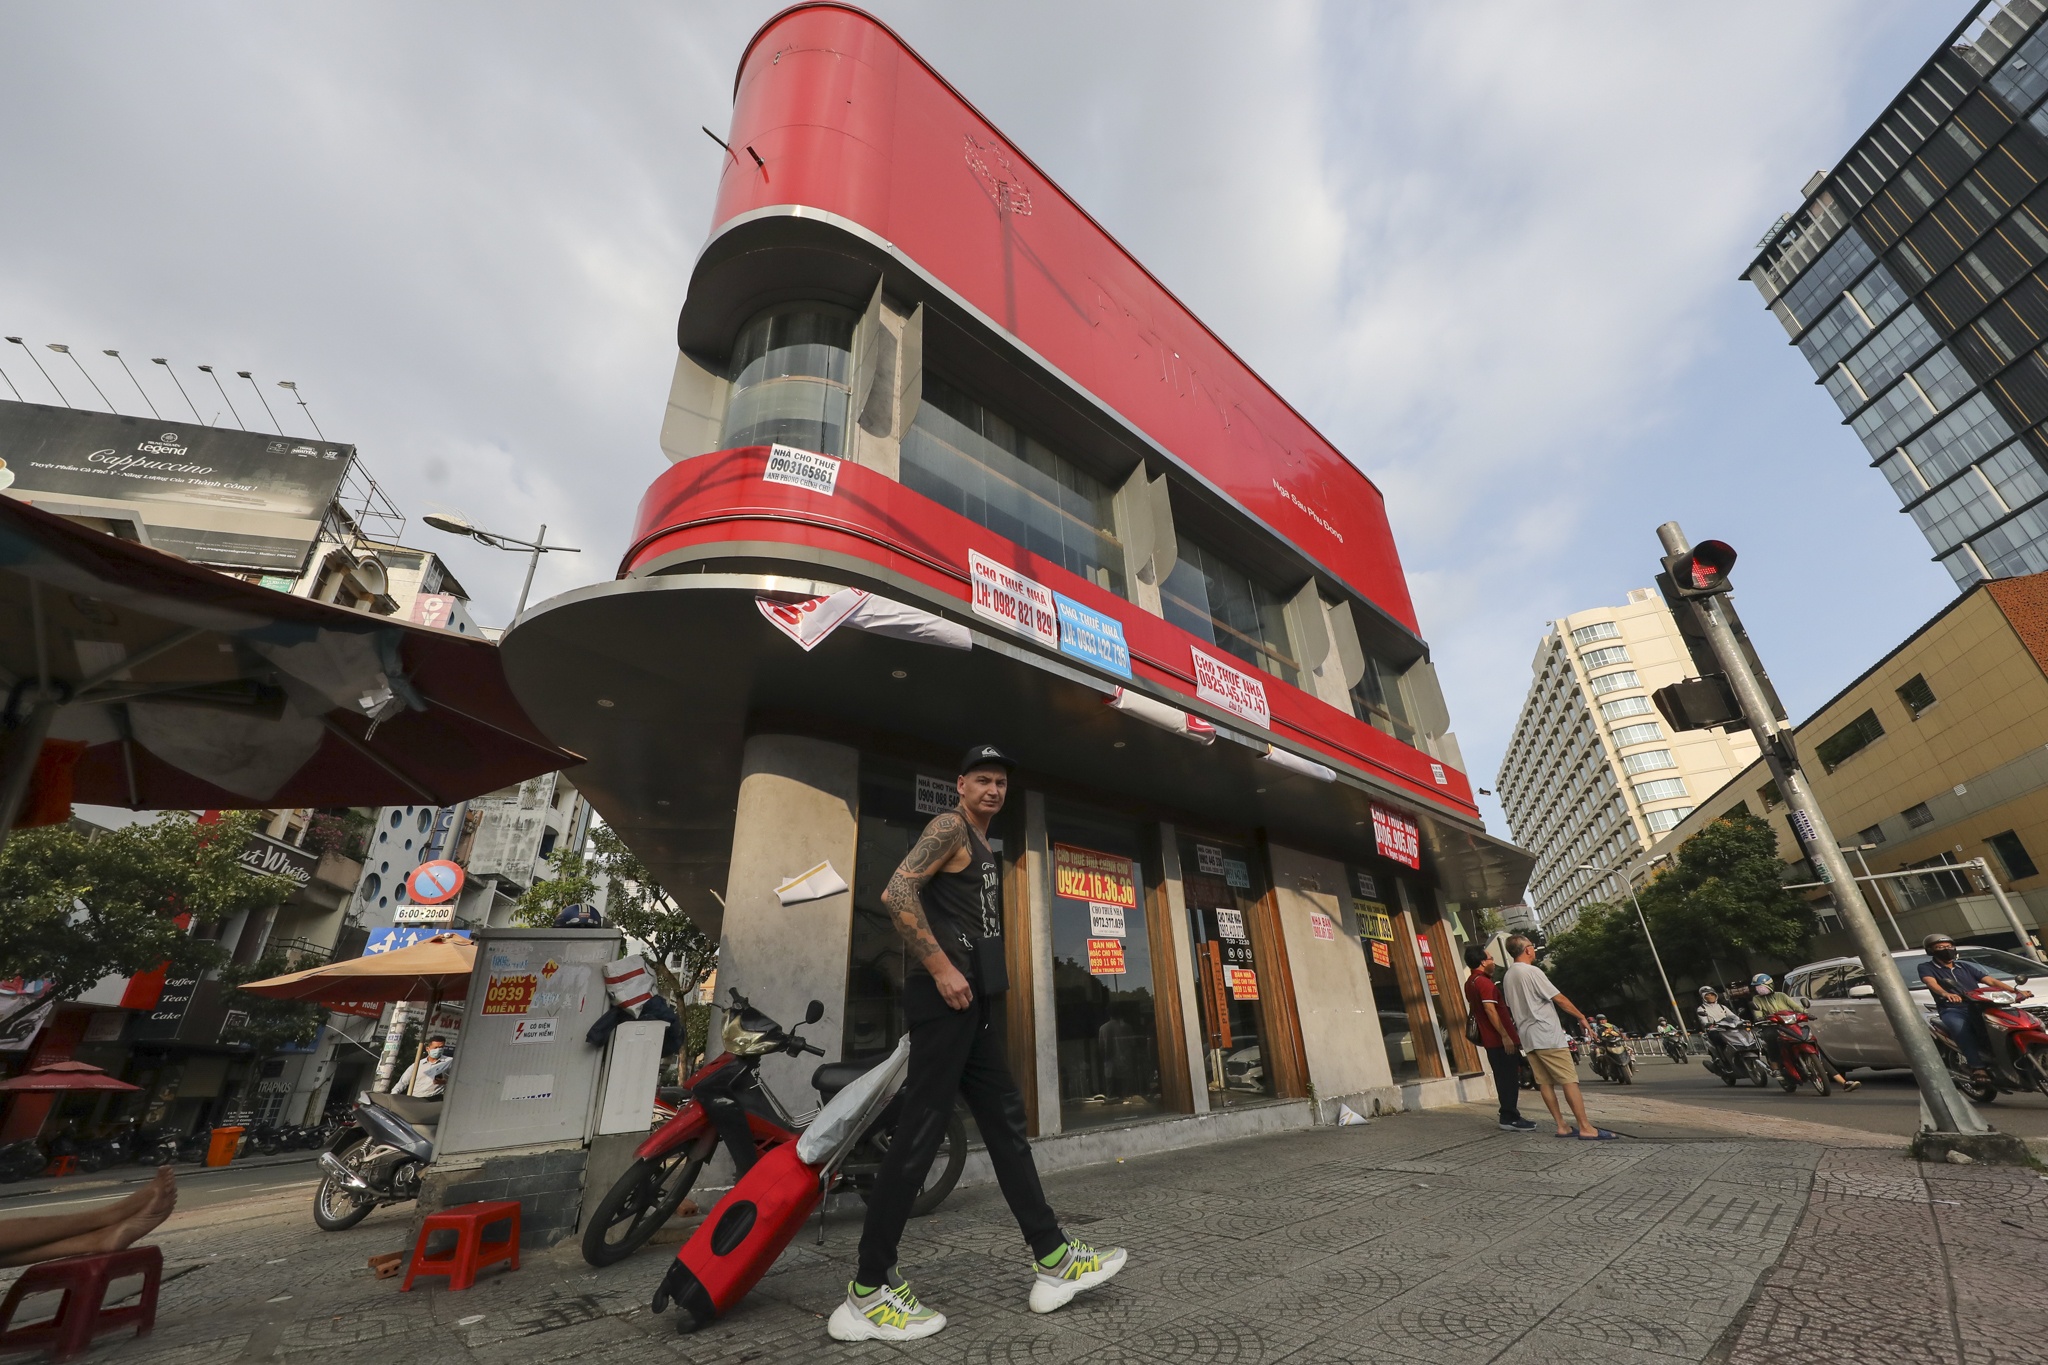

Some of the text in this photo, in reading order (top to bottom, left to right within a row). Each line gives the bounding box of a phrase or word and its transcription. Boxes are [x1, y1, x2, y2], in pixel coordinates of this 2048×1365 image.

[138, 443, 188, 456] Legend
[89, 449, 218, 475] Cappuccino
[773, 448, 836, 471] NHÀ CHO THUÊ
[767, 472, 780, 480] ANH
[770, 457, 833, 485] 0903165861
[188, 478, 221, 487] Thành
[223, 482, 252, 491] Công
[1272, 477, 1290, 500] Nga
[1291, 493, 1308, 513] Sau
[1307, 506, 1323, 526] Phu
[976, 562, 1048, 606] CHO THUÊ NHÀ
[976, 580, 1052, 637] LH: 0982 821 829
[1060, 602, 1120, 642] CHO THUÊ NHÀ
[1062, 620, 1127, 669] LH: 0933 422 735
[1195, 654, 1215, 676] CHO
[1216, 665, 1242, 690] THUÊ
[1198, 669, 1266, 716] 0925.45.47.47
[918, 778, 958, 794] NHÀ CHO THU
[262, 845, 311, 882] White
[1058, 865, 1134, 905] 0922.16.36.36
[399, 909, 420, 918] 6:00
[425, 909, 450, 918] 20:00
[1092, 905, 1102, 914] CHO
[1102, 905, 1113, 915] THUÊ
[1093, 916, 1124, 929] 0972.377.039
[1092, 941, 1118, 949] BÁN NHÀ
[1091, 958, 1124, 967] 0939 11 66 79
[165, 977, 196, 987] Coffee
[162, 994, 190, 1002] Teas
[488, 986, 525, 1001] 0939
[485, 1002, 516, 1013] MIỄN
[151, 1011, 182, 1020] Cake
[530, 1022, 551, 1031] CÓ ĐIỆN
[538, 1029, 554, 1037] HIỂM!
